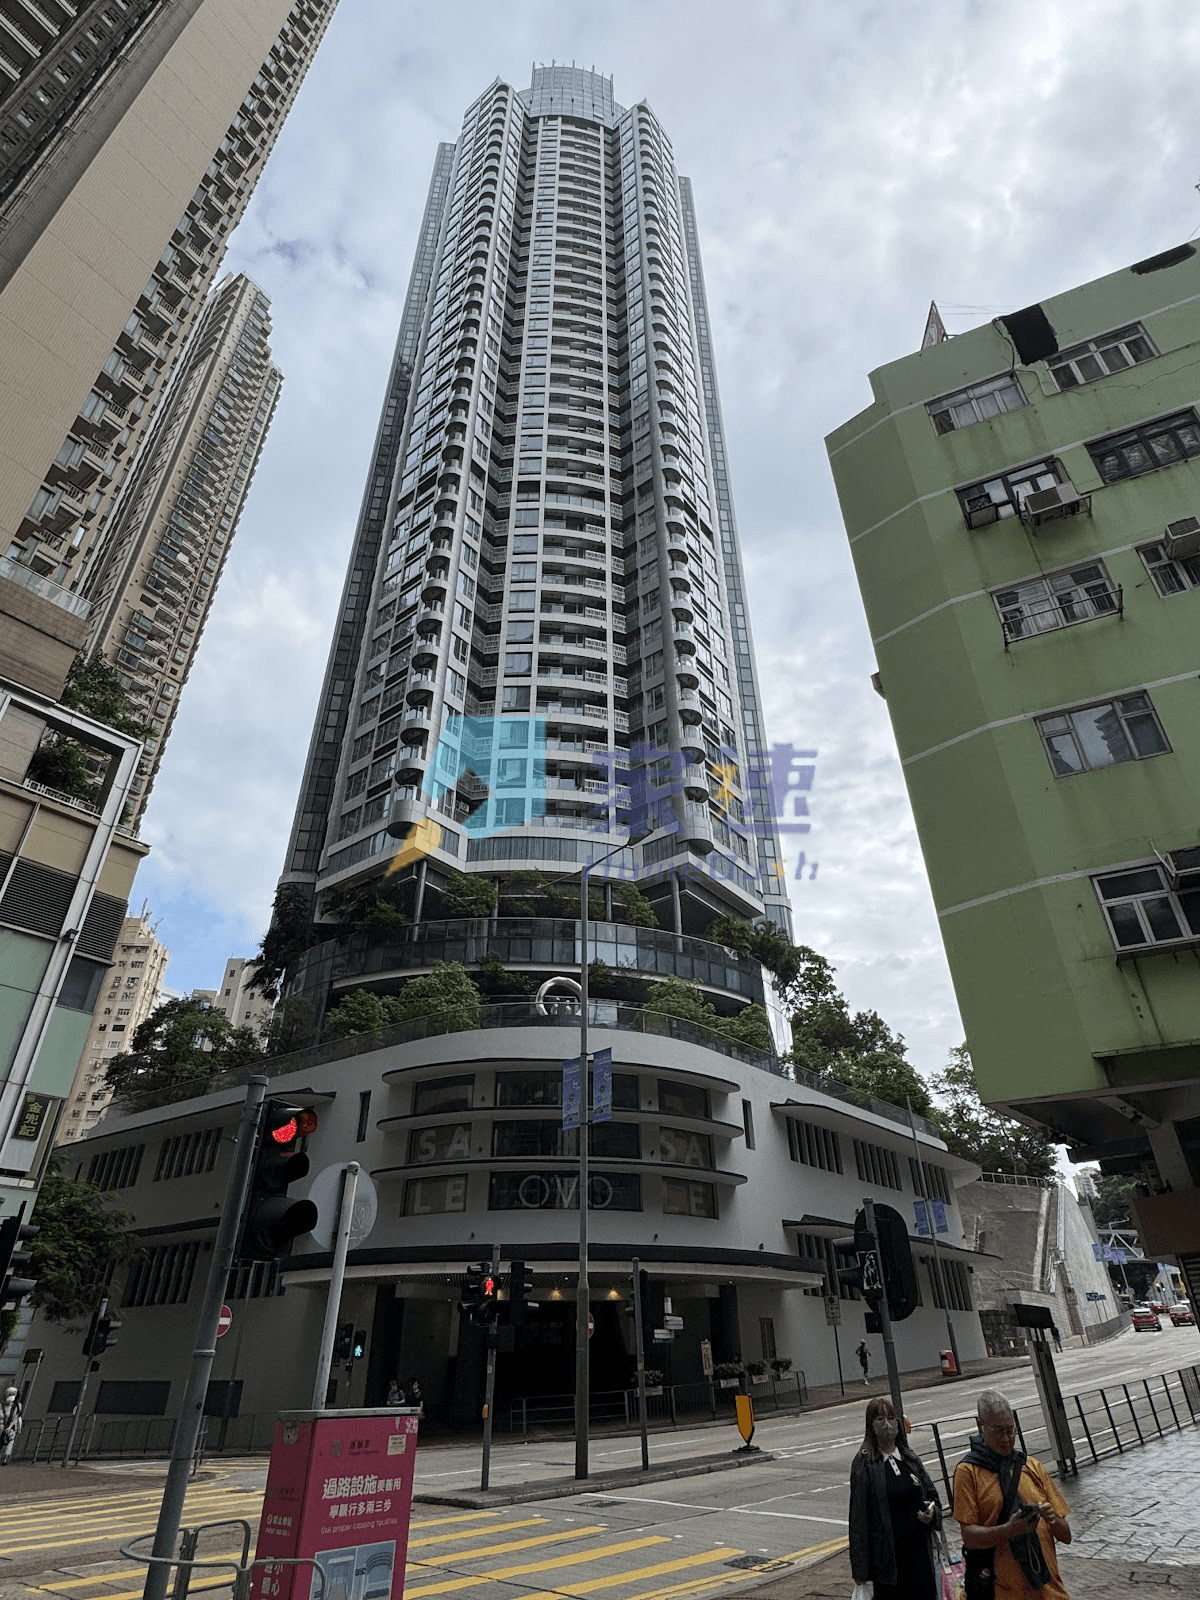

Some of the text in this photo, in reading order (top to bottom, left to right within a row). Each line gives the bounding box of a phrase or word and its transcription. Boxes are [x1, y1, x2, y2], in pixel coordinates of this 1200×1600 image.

[518, 1175, 614, 1209] OVO
[322, 1474, 402, 1500] 過路設施要善用
